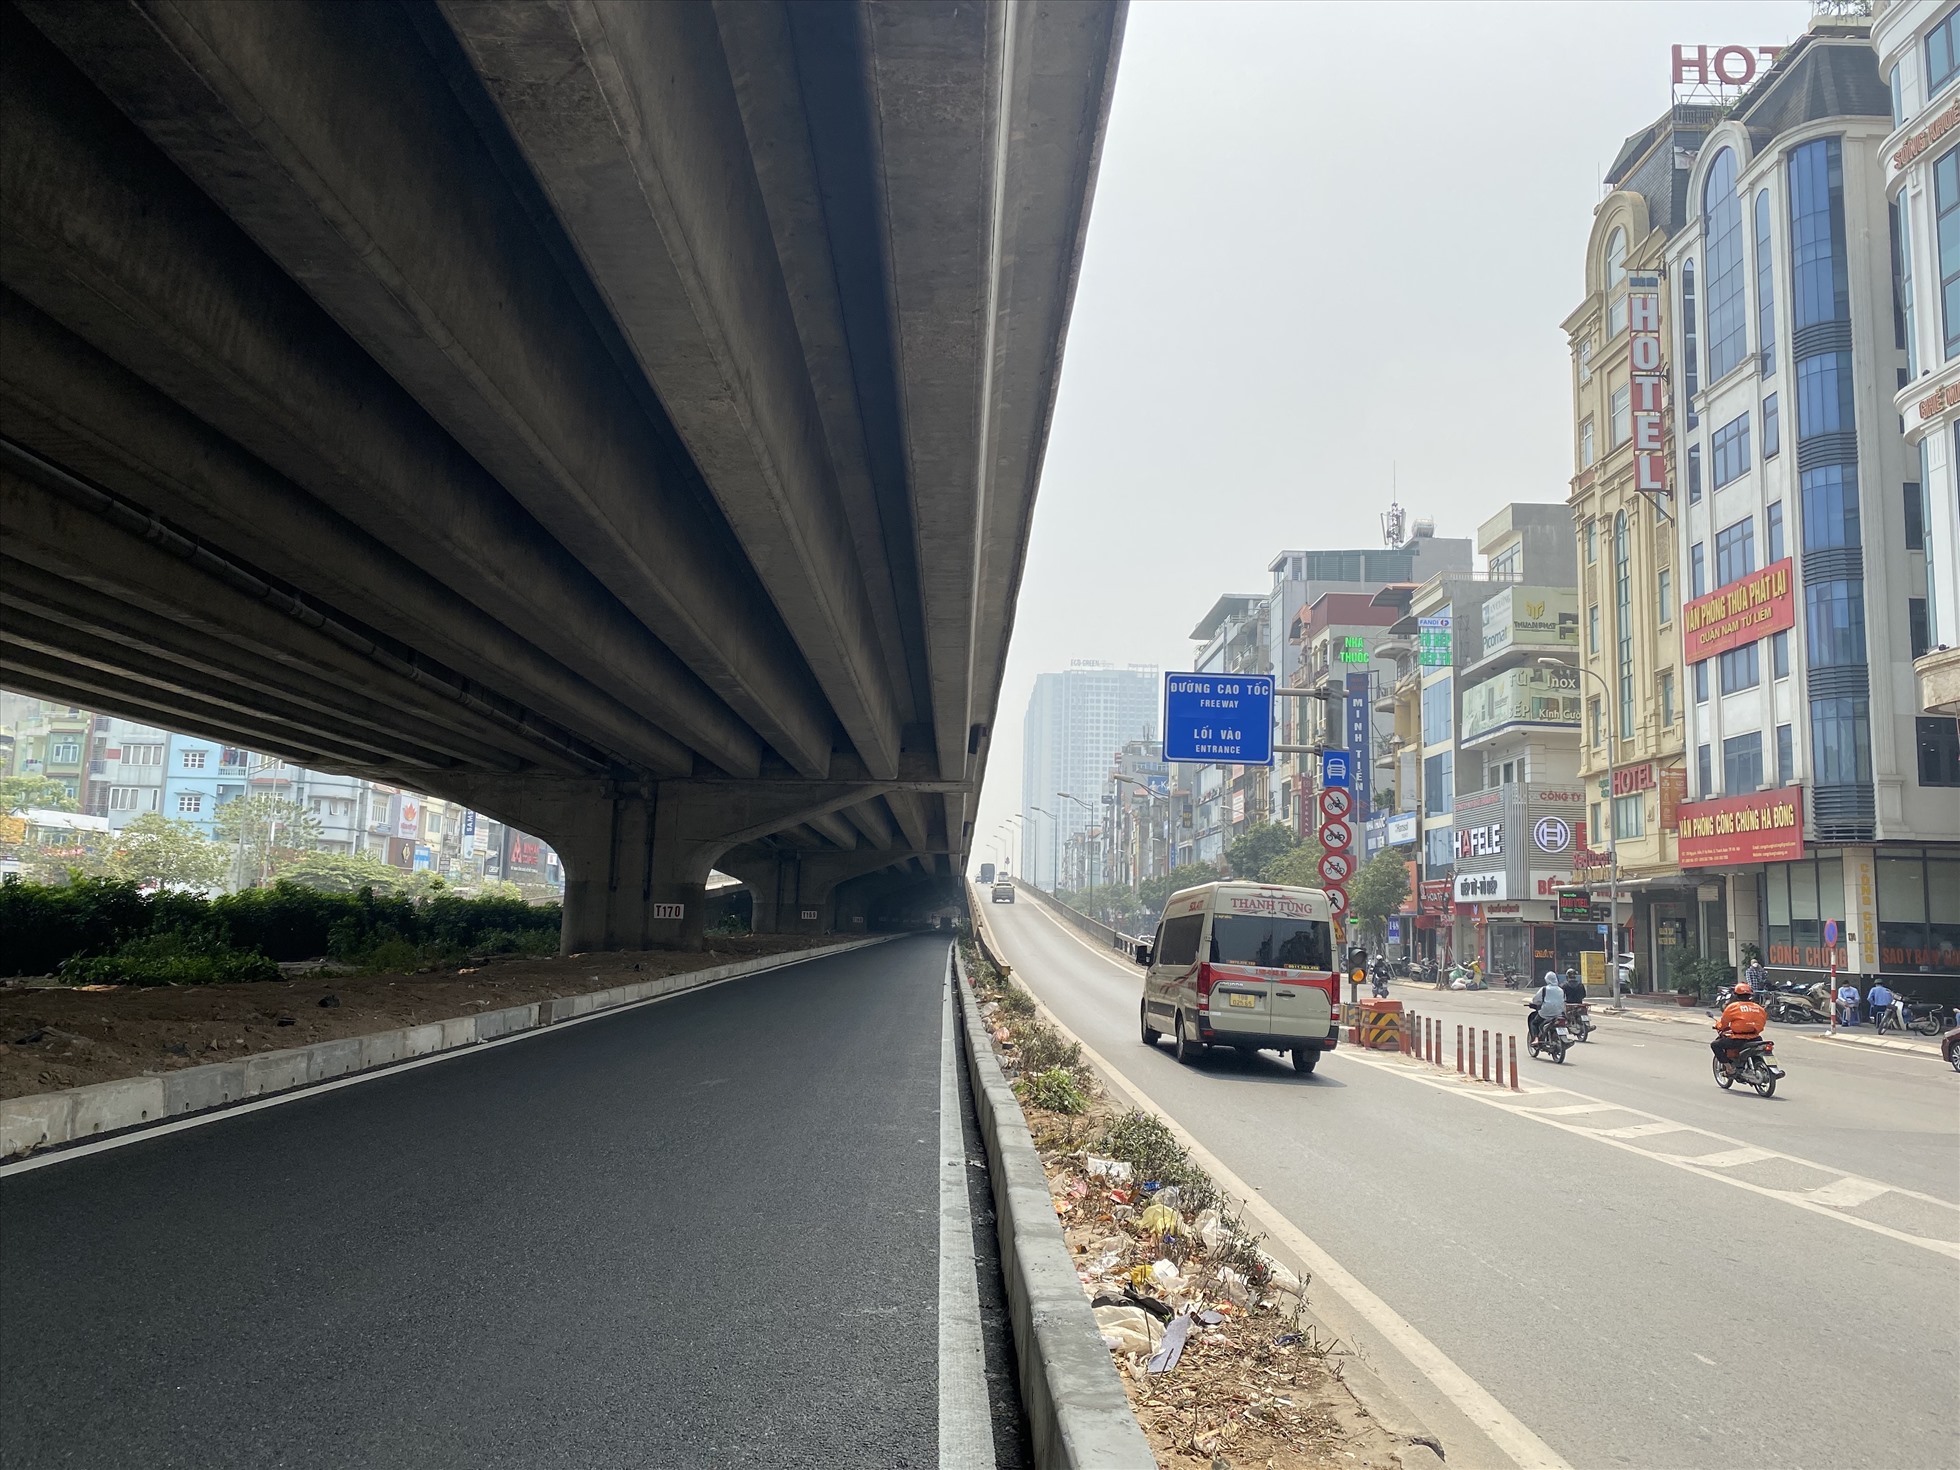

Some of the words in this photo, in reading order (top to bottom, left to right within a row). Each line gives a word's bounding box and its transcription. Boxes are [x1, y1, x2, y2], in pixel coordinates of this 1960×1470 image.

[1631, 297, 1661, 488] HOTEL
[1701, 596, 1726, 627] PHÒNG
[1749, 573, 1771, 607] PHÁT
[1772, 569, 1788, 600] LẠI
[1700, 627, 1721, 644] QUẬN
[1721, 620, 1740, 636] NAM
[1753, 607, 1773, 623] LIÊM
[1340, 649, 1370, 663] THUỐC
[1171, 680, 1210, 694] ĐƯỜNG
[1217, 684, 1240, 695] CAO
[1247, 681, 1269, 696] TỐC
[1547, 675, 1577, 689] Inox
[1200, 699, 1239, 708] FREEWAY
[1353, 698, 1363, 742] MINH
[1194, 725, 1212, 739] LỐI
[1221, 727, 1241, 740] VÀO
[1195, 745, 1241, 754] ENTRANCE
[1613, 763, 1656, 796] HOTEL
[1540, 790, 1569, 801] CÔNG
[1571, 791, 1581, 801] TY
[1679, 815, 1692, 839] VĂN
[1693, 812, 1714, 837] PHÒNG
[1716, 809, 1734, 834] CÔNG
[1735, 805, 1759, 832] CHỨNG
[1761, 803, 1772, 829] HÀ
[1773, 800, 1795, 827] ĐÔNG
[1860, 863, 1872, 906] CÔNG
[656, 905, 681, 917] T170
[1231, 898, 1274, 910] THANH
[1278, 899, 1313, 914] TÙNG
[1863, 911, 1875, 964] CHỨNG
[1769, 944, 1800, 965] CÔNG
[1883, 947, 1904, 964] SAO
[1905, 947, 1912, 964] Y
